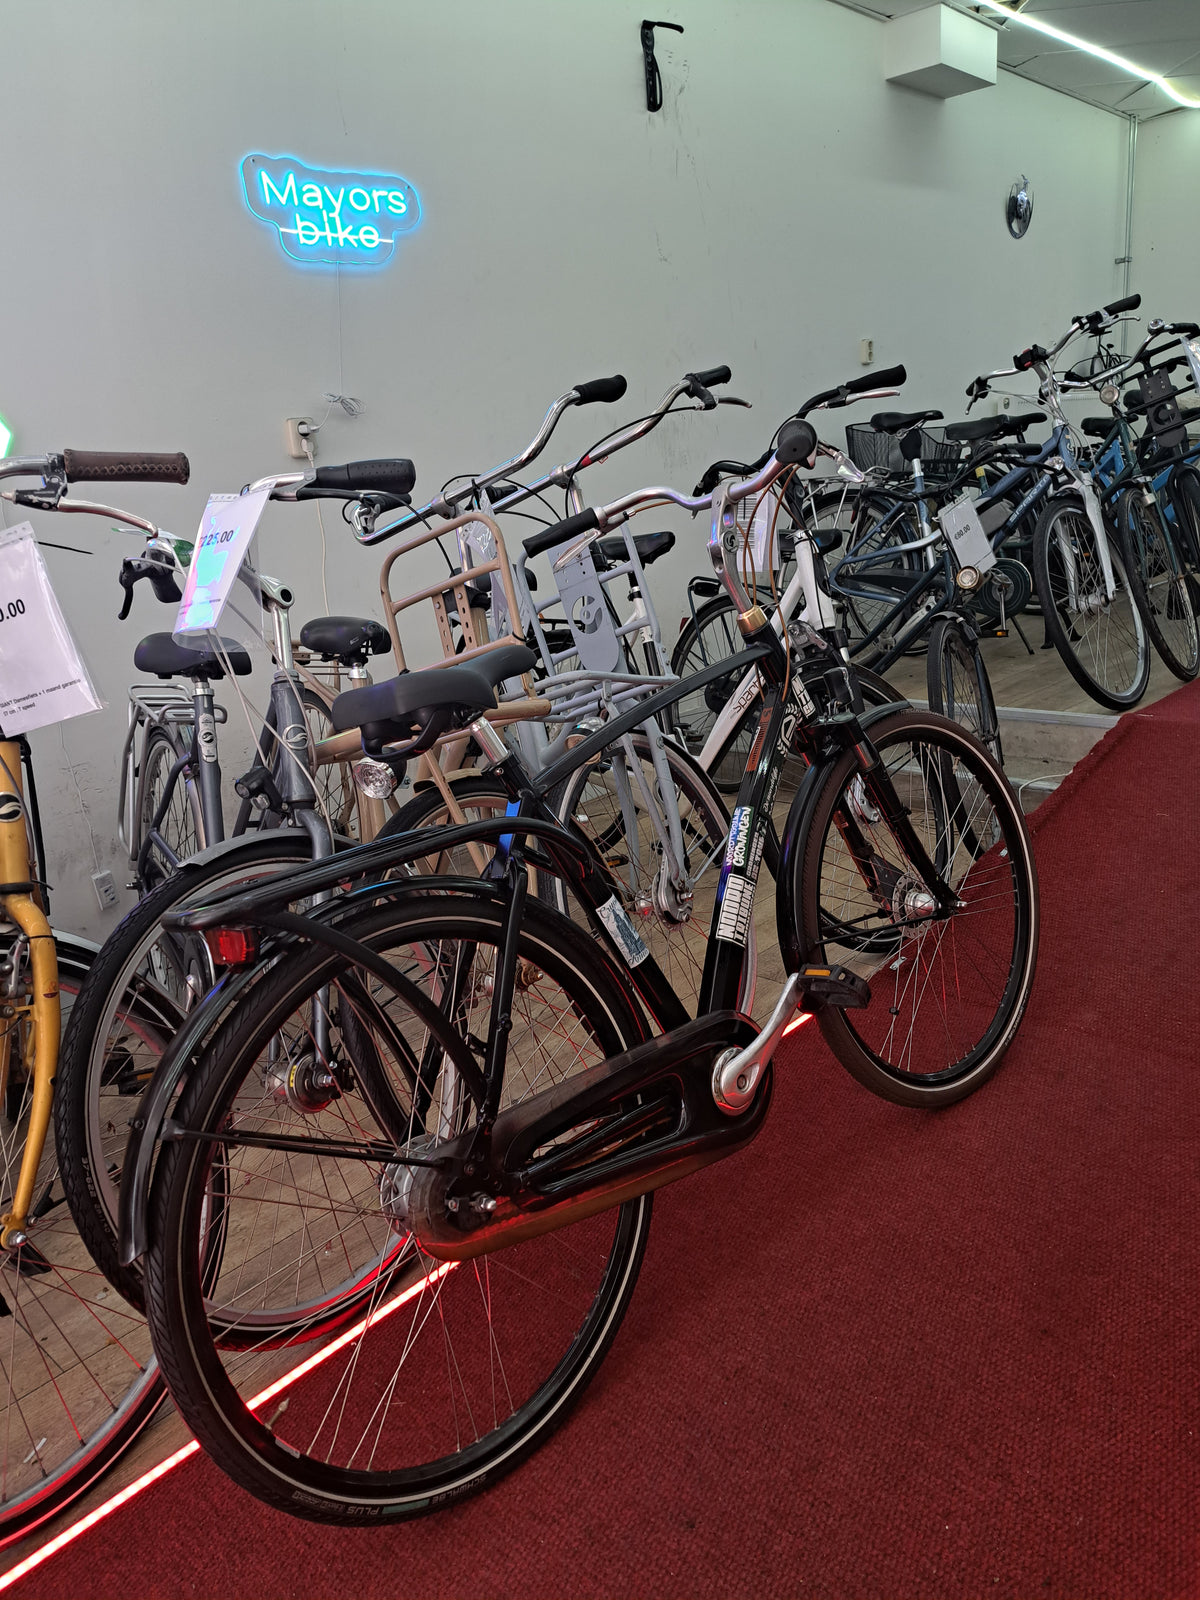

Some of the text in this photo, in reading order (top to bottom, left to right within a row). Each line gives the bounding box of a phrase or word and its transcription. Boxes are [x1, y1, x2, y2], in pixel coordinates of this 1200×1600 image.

[260, 170, 407, 217] Mayors
[295, 210, 380, 248] bike
[718, 877, 745, 939] NOORD
[346, 1473, 487, 1516] SCHWALBE PLUS
